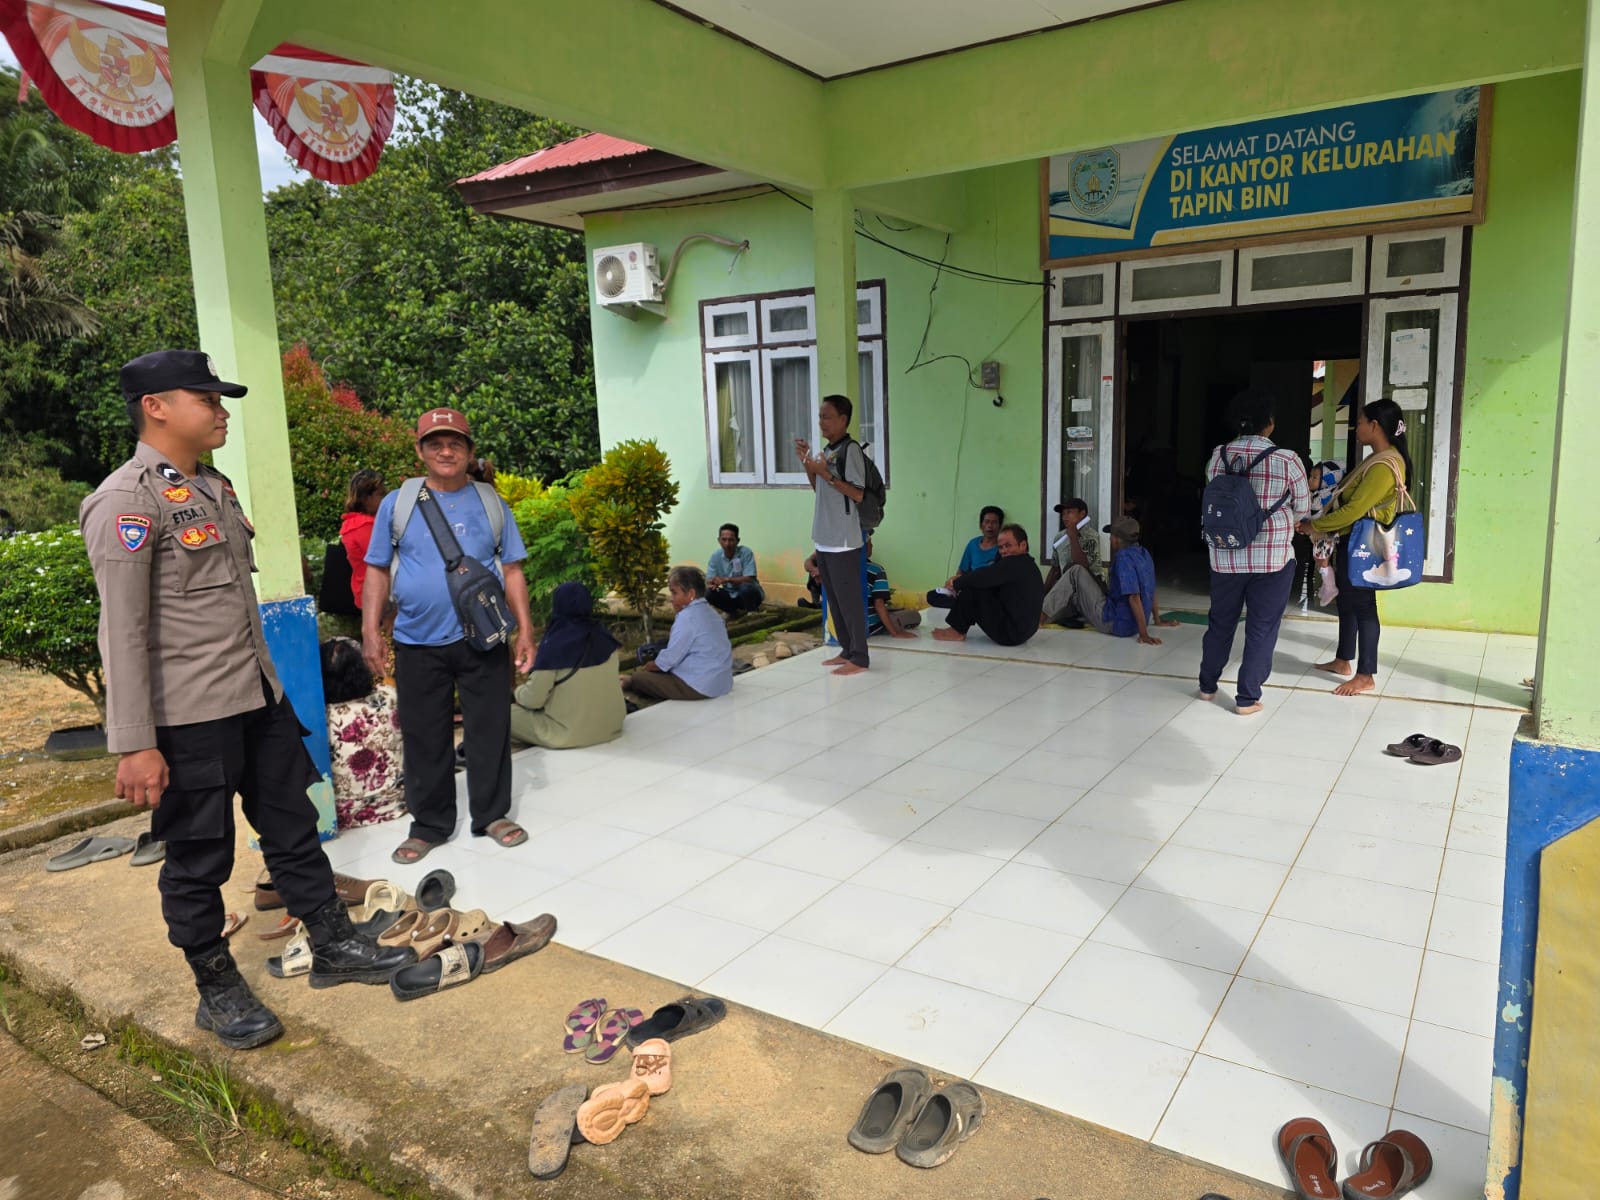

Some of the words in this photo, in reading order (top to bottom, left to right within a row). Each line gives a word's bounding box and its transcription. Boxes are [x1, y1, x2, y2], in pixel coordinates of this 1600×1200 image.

[1170, 167, 1192, 193] DI
[1200, 153, 1294, 189] KANTOR
[1301, 130, 1457, 175] KELURAHAN
[1171, 135, 1259, 167] SELAMAT
[1265, 121, 1356, 153] DATANG
[1169, 189, 1233, 219] TAPIN
[1240, 181, 1289, 210] BINI
